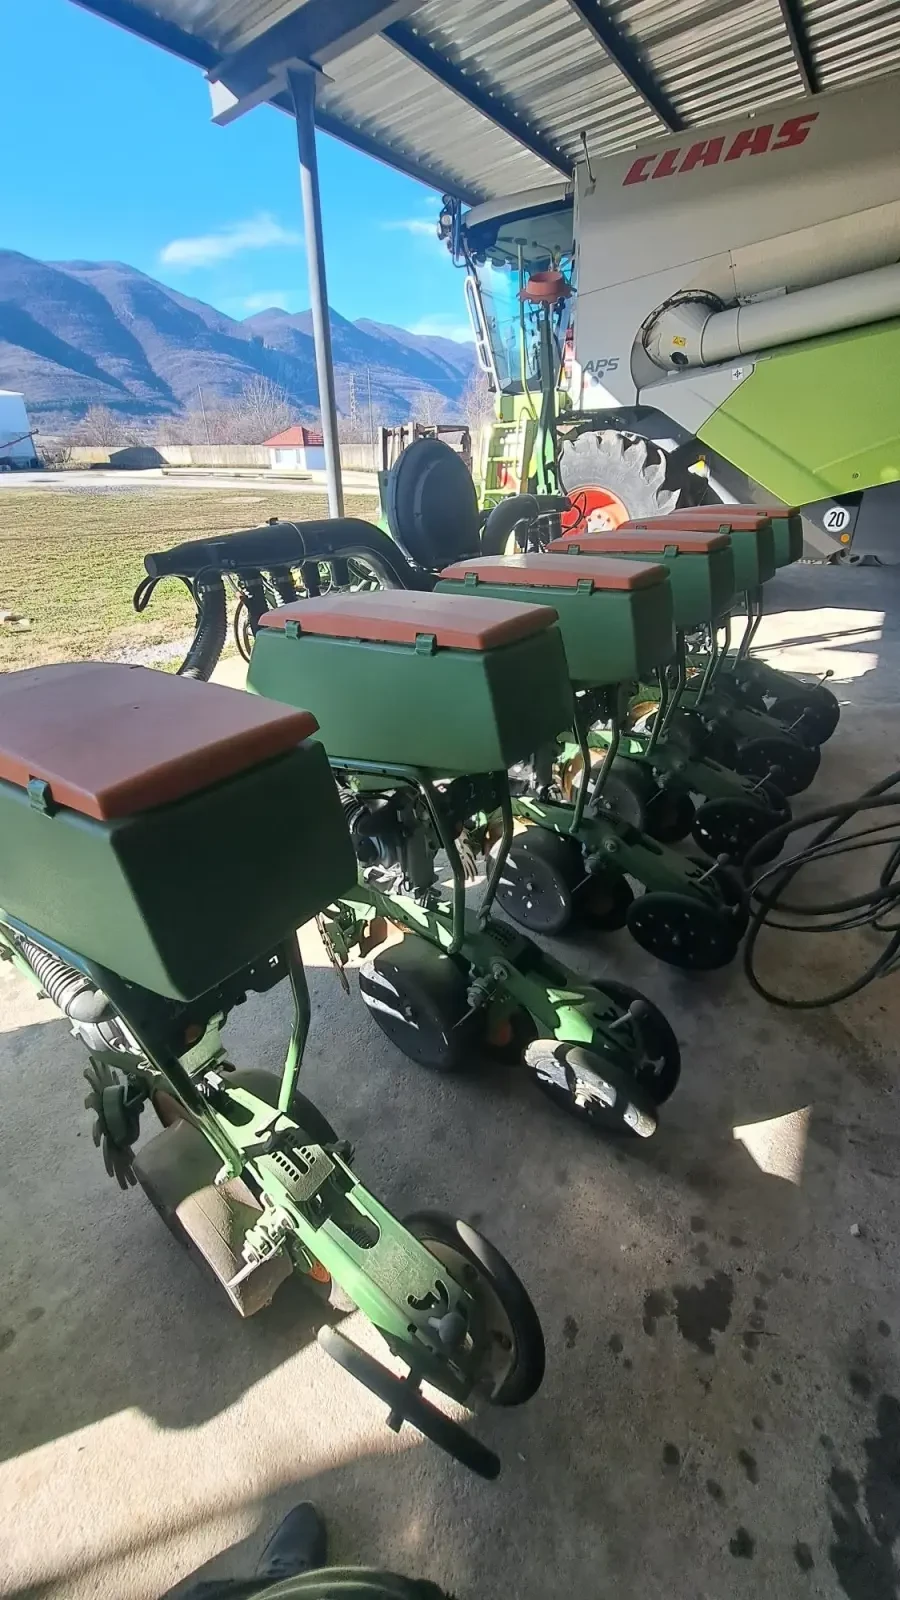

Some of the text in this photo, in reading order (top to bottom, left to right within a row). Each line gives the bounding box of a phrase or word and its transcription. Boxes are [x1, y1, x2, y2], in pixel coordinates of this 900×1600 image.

[622, 112, 820, 186] CLAAS
[582, 357, 620, 373] APS
[828, 511, 845, 527] 20
